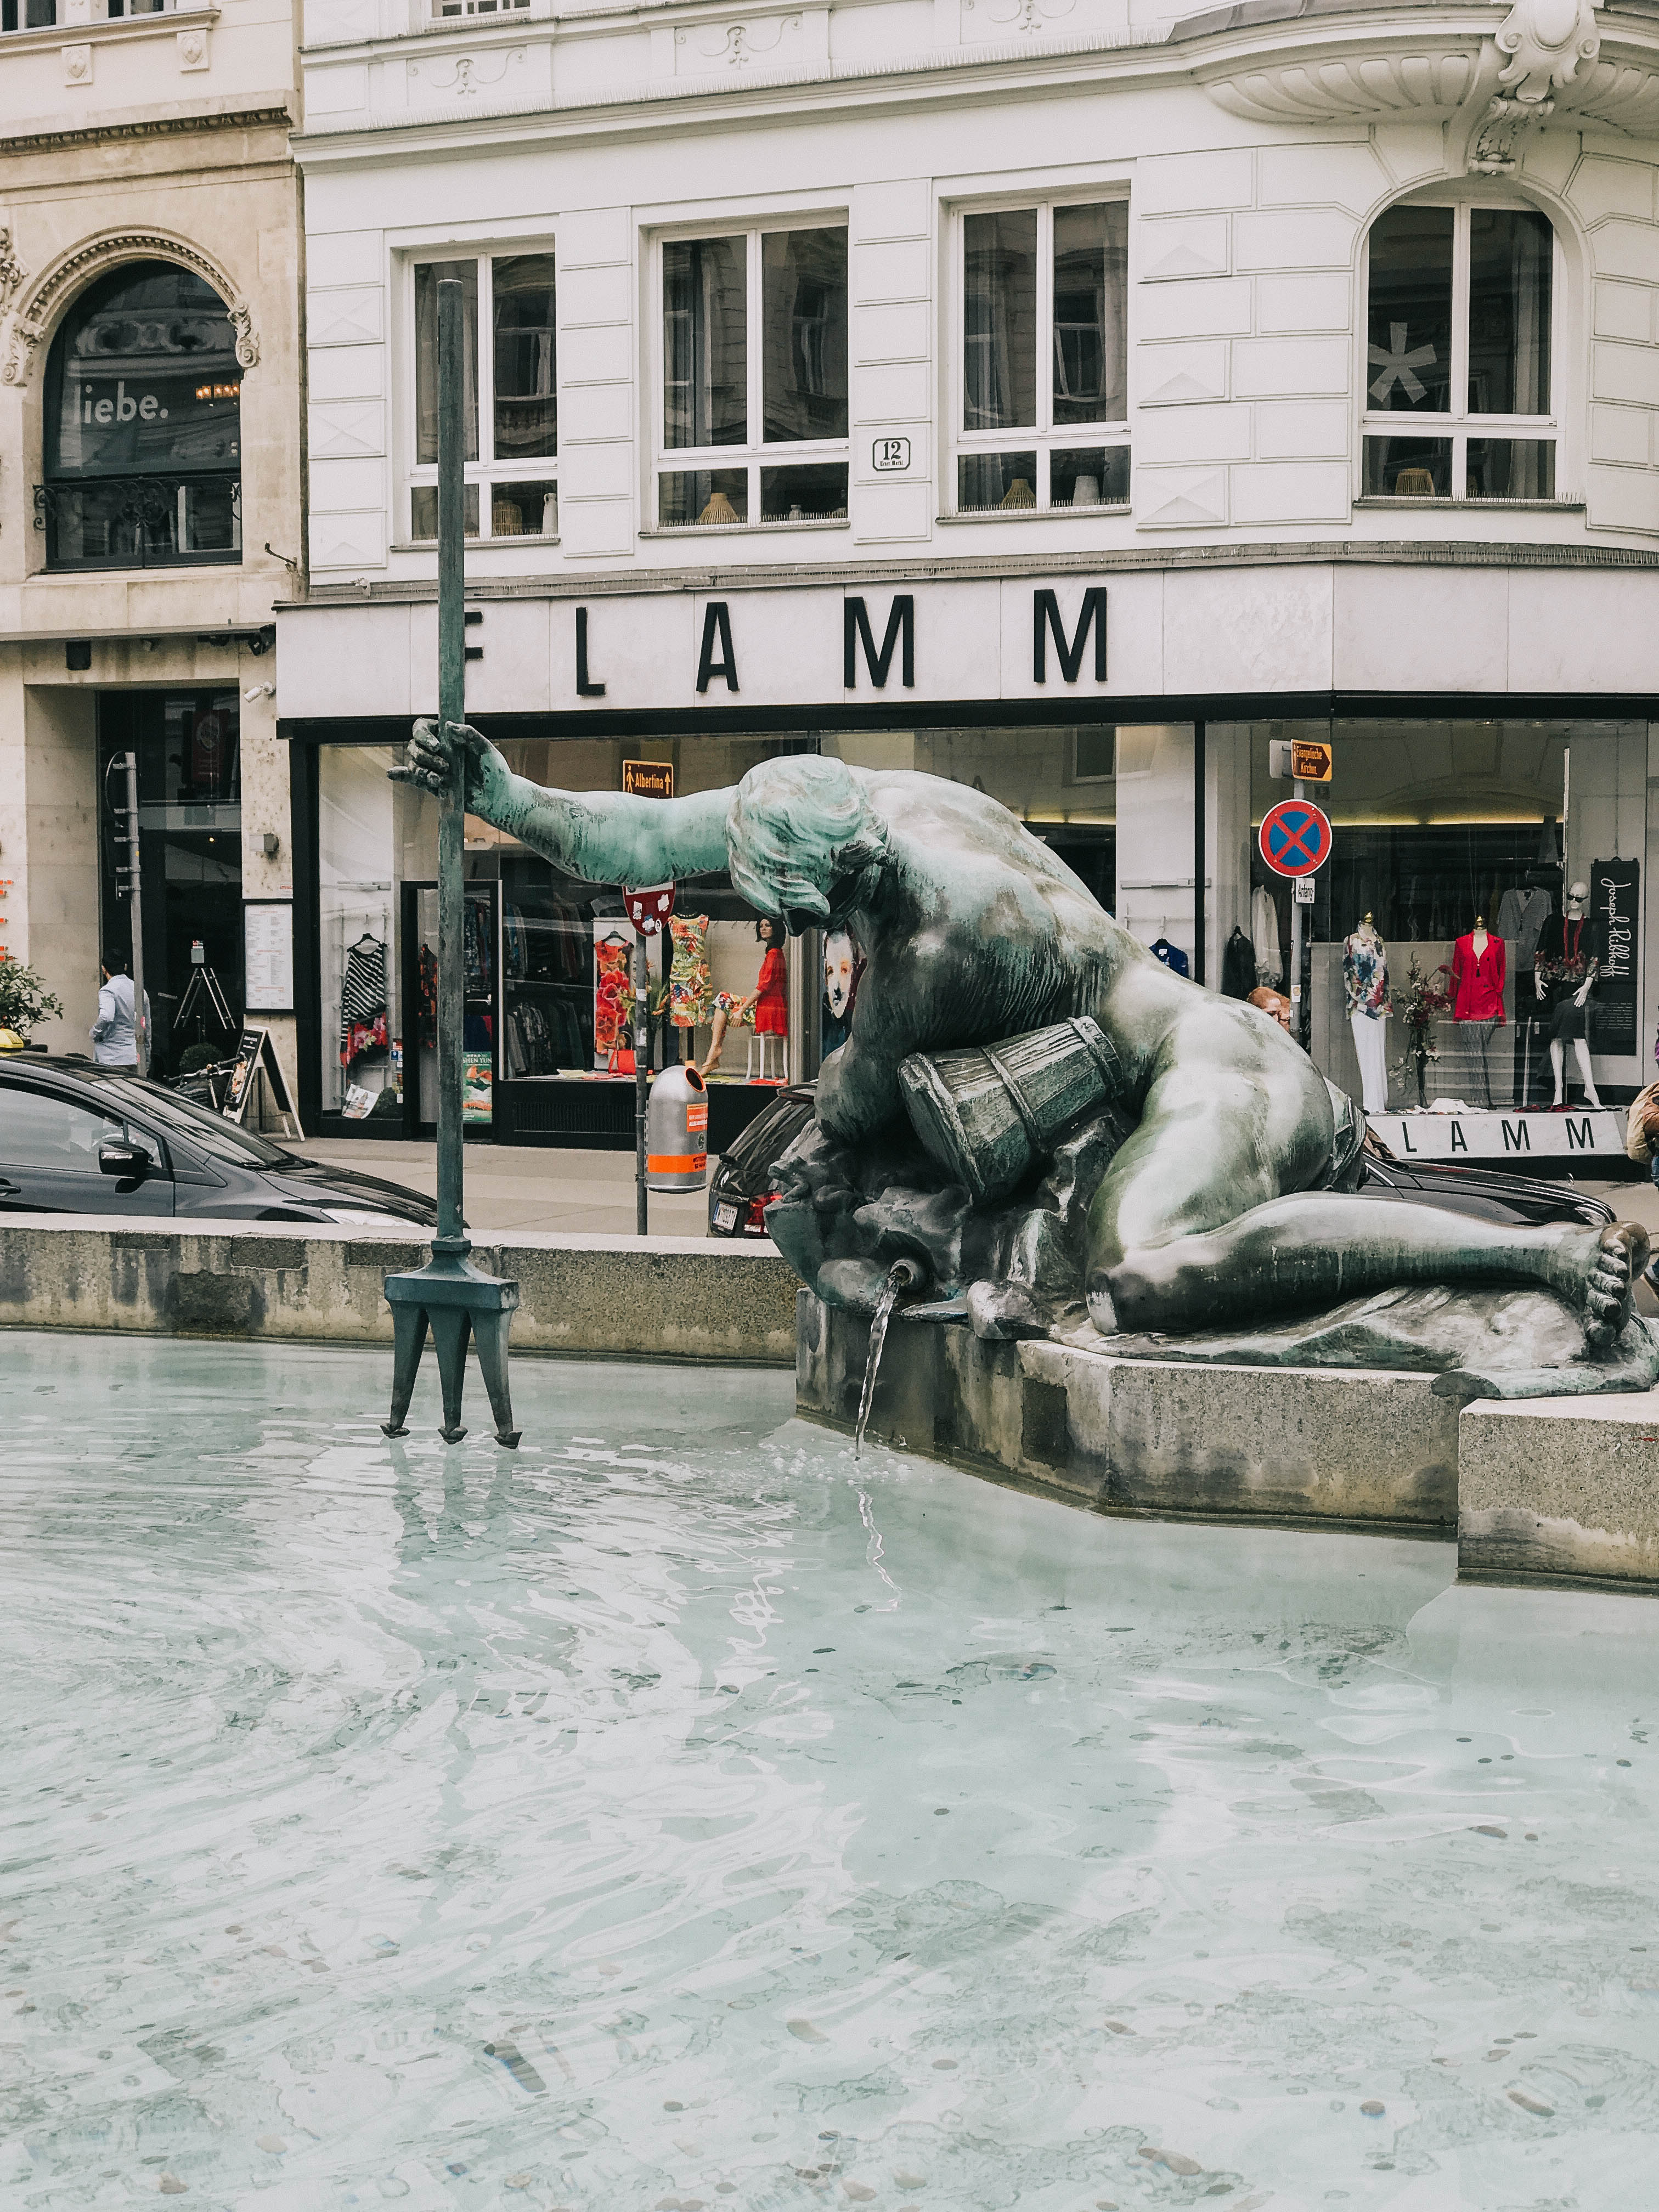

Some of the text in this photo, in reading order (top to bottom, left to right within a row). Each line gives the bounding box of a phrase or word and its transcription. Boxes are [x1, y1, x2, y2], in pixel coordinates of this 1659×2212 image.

[883, 441, 901, 460] 12
[635, 772, 663, 789] Albertina
[1297, 883, 1314, 901] Anfang
[1600, 878, 1632, 926] Joseph
[1600, 926, 1632, 977] Ribkoff
[1402, 1117, 1595, 1153] LAMM
